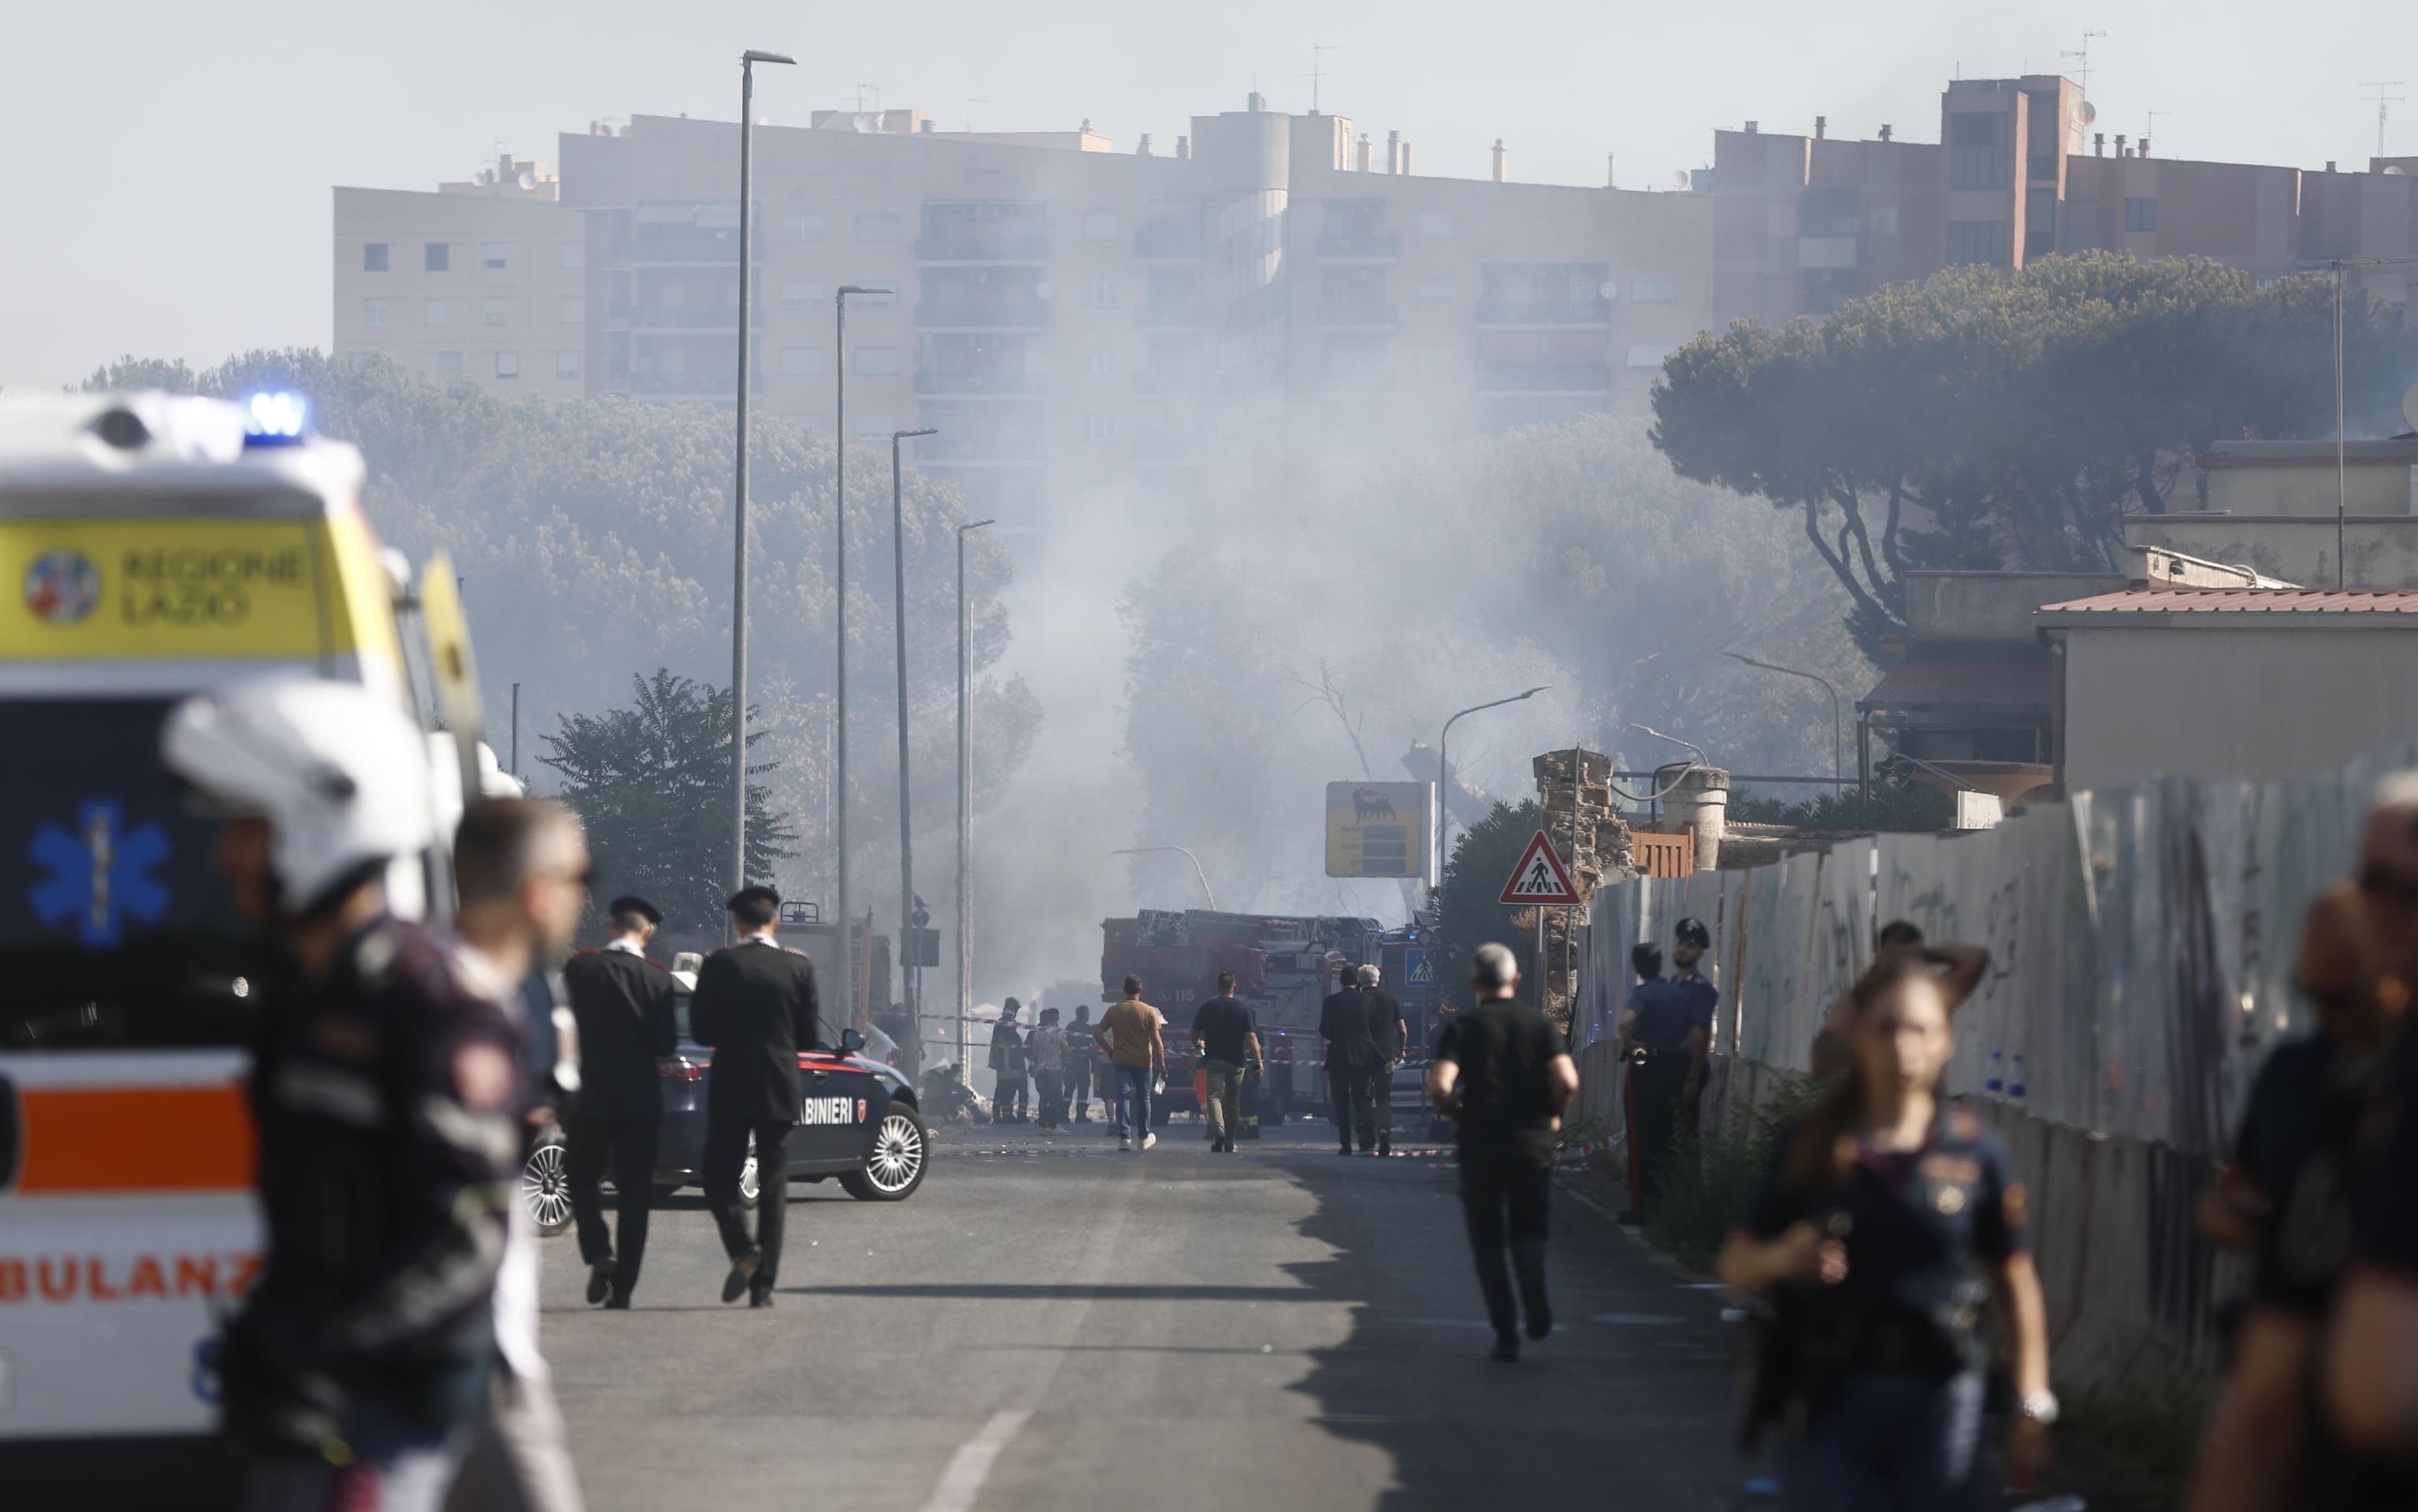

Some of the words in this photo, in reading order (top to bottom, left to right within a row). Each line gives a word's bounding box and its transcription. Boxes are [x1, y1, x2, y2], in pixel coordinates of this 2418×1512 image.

[123, 549, 303, 585] REGIONE
[123, 589, 249, 626] LAZIO
[1175, 988, 1194, 1001] 115
